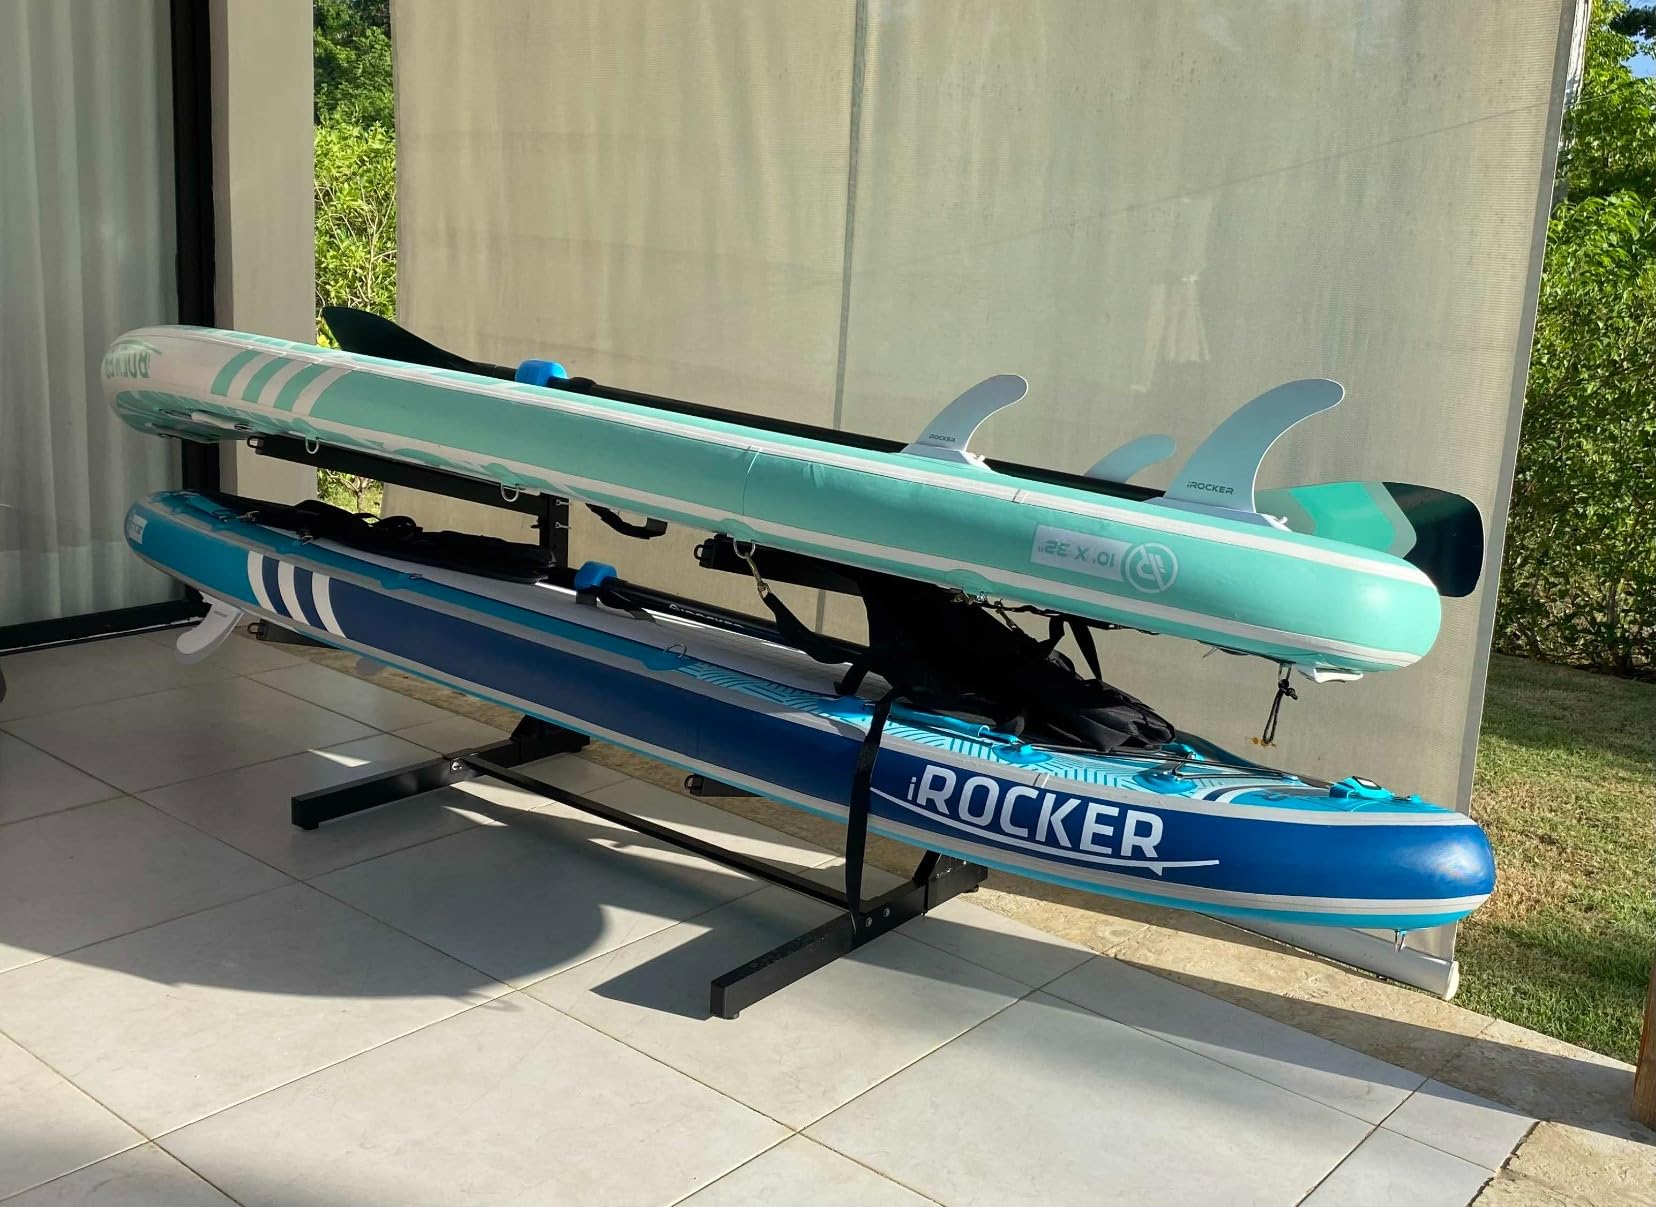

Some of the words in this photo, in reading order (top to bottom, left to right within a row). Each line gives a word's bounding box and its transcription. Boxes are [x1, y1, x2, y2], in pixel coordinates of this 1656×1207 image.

[1187, 480, 1234, 495] iROCKER
[1073, 545, 1090, 562] X
[906, 764, 1164, 858] iROCKER
